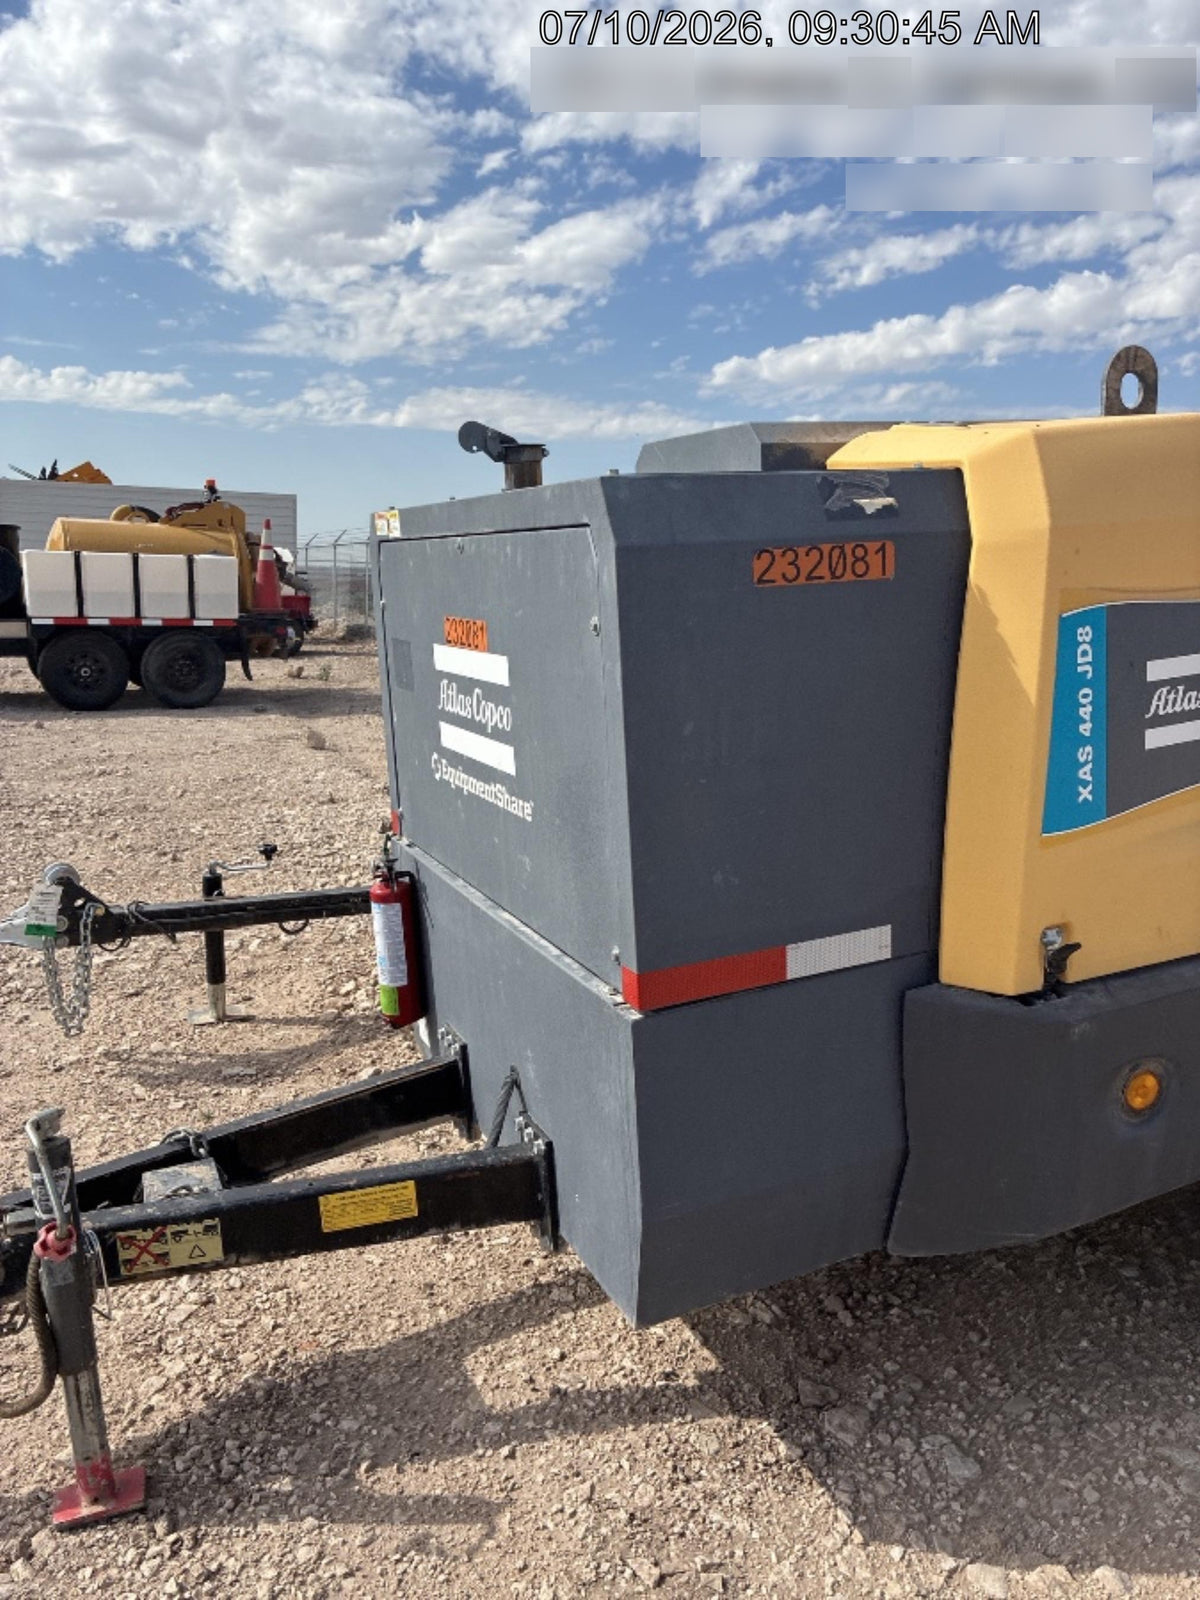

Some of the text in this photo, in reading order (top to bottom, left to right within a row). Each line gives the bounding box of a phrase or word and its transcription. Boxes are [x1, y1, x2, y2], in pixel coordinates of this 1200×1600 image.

[756, 542, 887, 585] 232081
[1077, 625, 1093, 803] XAS 440 JD8
